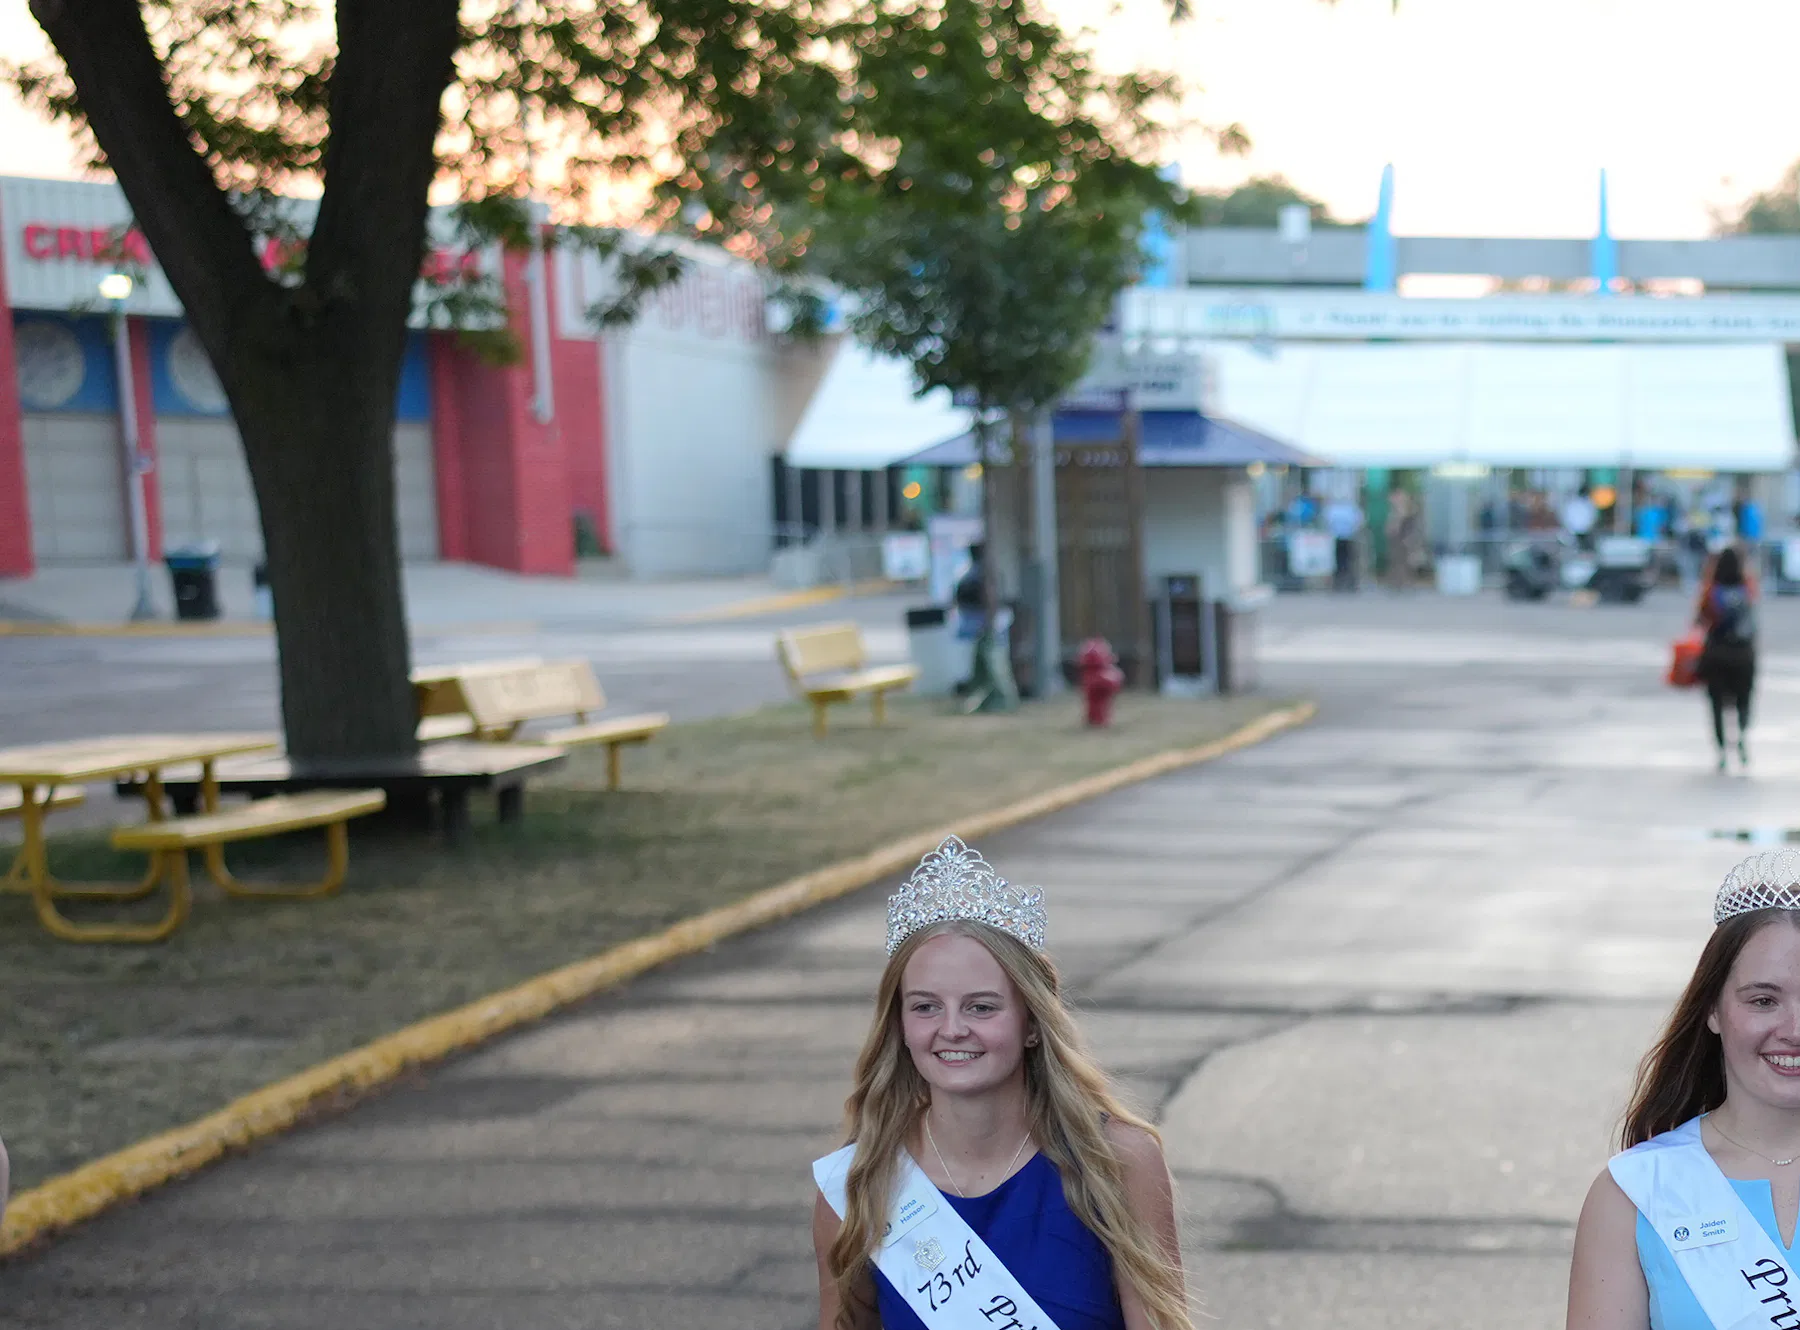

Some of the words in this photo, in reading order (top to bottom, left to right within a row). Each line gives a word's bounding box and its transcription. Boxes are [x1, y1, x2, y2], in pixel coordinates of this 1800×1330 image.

[900, 1198, 917, 1214] Jena
[900, 1203, 926, 1225] Hanson
[1700, 1219, 1726, 1229] Jaiden
[1702, 1228, 1725, 1237] Smith
[917, 1239, 982, 1312] 73rd
